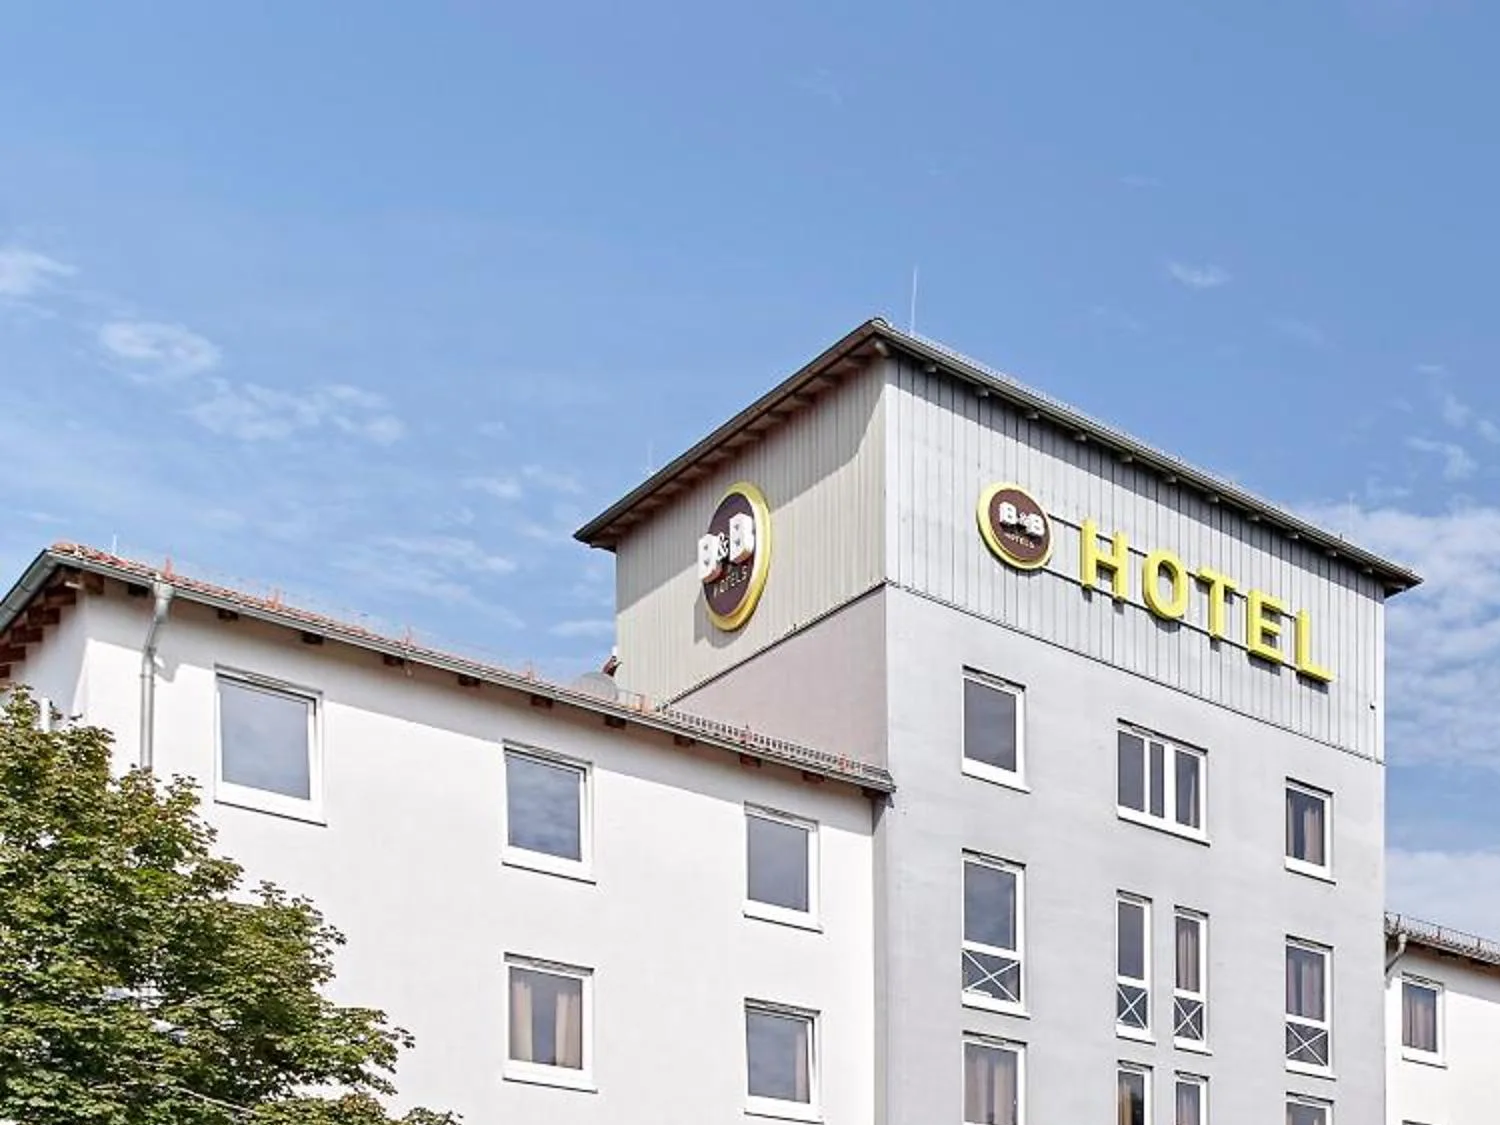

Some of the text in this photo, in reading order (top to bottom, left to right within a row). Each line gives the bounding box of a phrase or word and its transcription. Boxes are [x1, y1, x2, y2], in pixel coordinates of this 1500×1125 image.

[698, 513, 754, 583] B&B
[999, 501, 1045, 536] B&B
[1080, 518, 1334, 683] HOTEL
